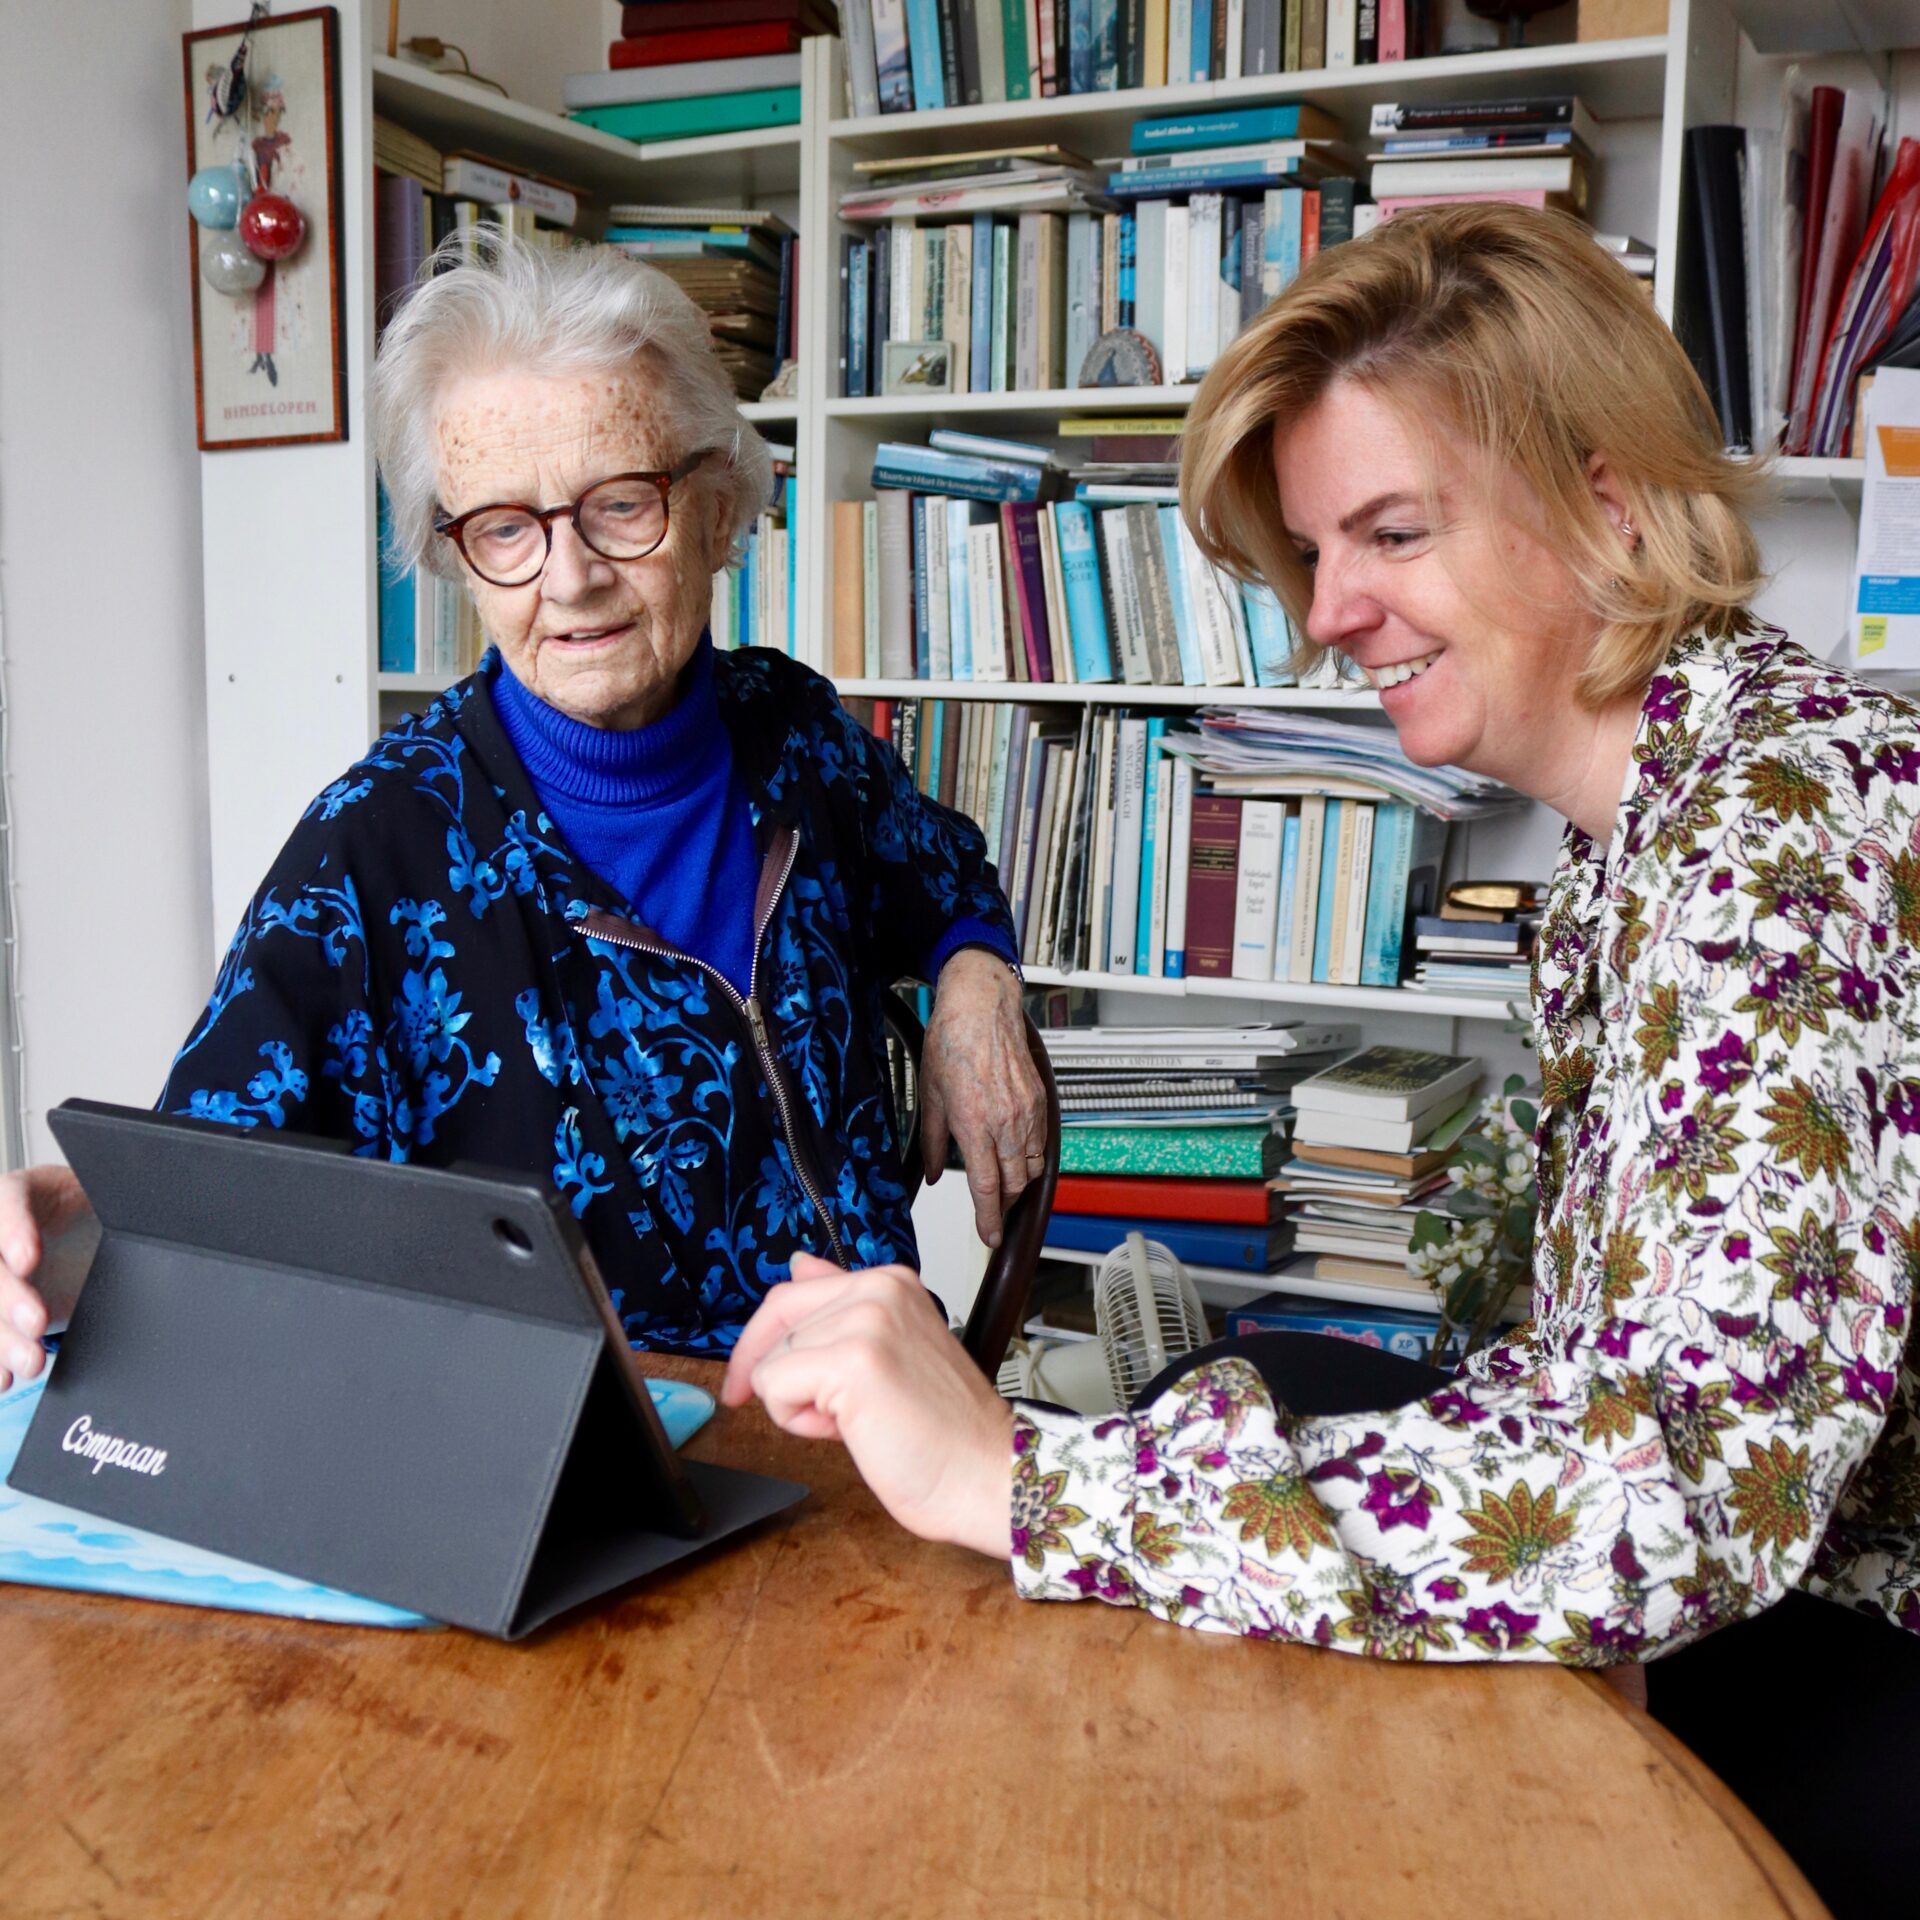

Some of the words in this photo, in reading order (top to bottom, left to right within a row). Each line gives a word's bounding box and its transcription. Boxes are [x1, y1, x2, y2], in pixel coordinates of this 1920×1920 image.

[1244, 217, 1261, 278] Allerzielen
[917, 507, 926, 531] ANNA
[918, 532, 927, 569] ENQUIST
[1121, 743, 1136, 820] SINT-GERLACH
[1133, 729, 1146, 790] LANDGOED
[1397, 1337, 1414, 1350] XP
[61, 1414, 169, 1477] Compaan
